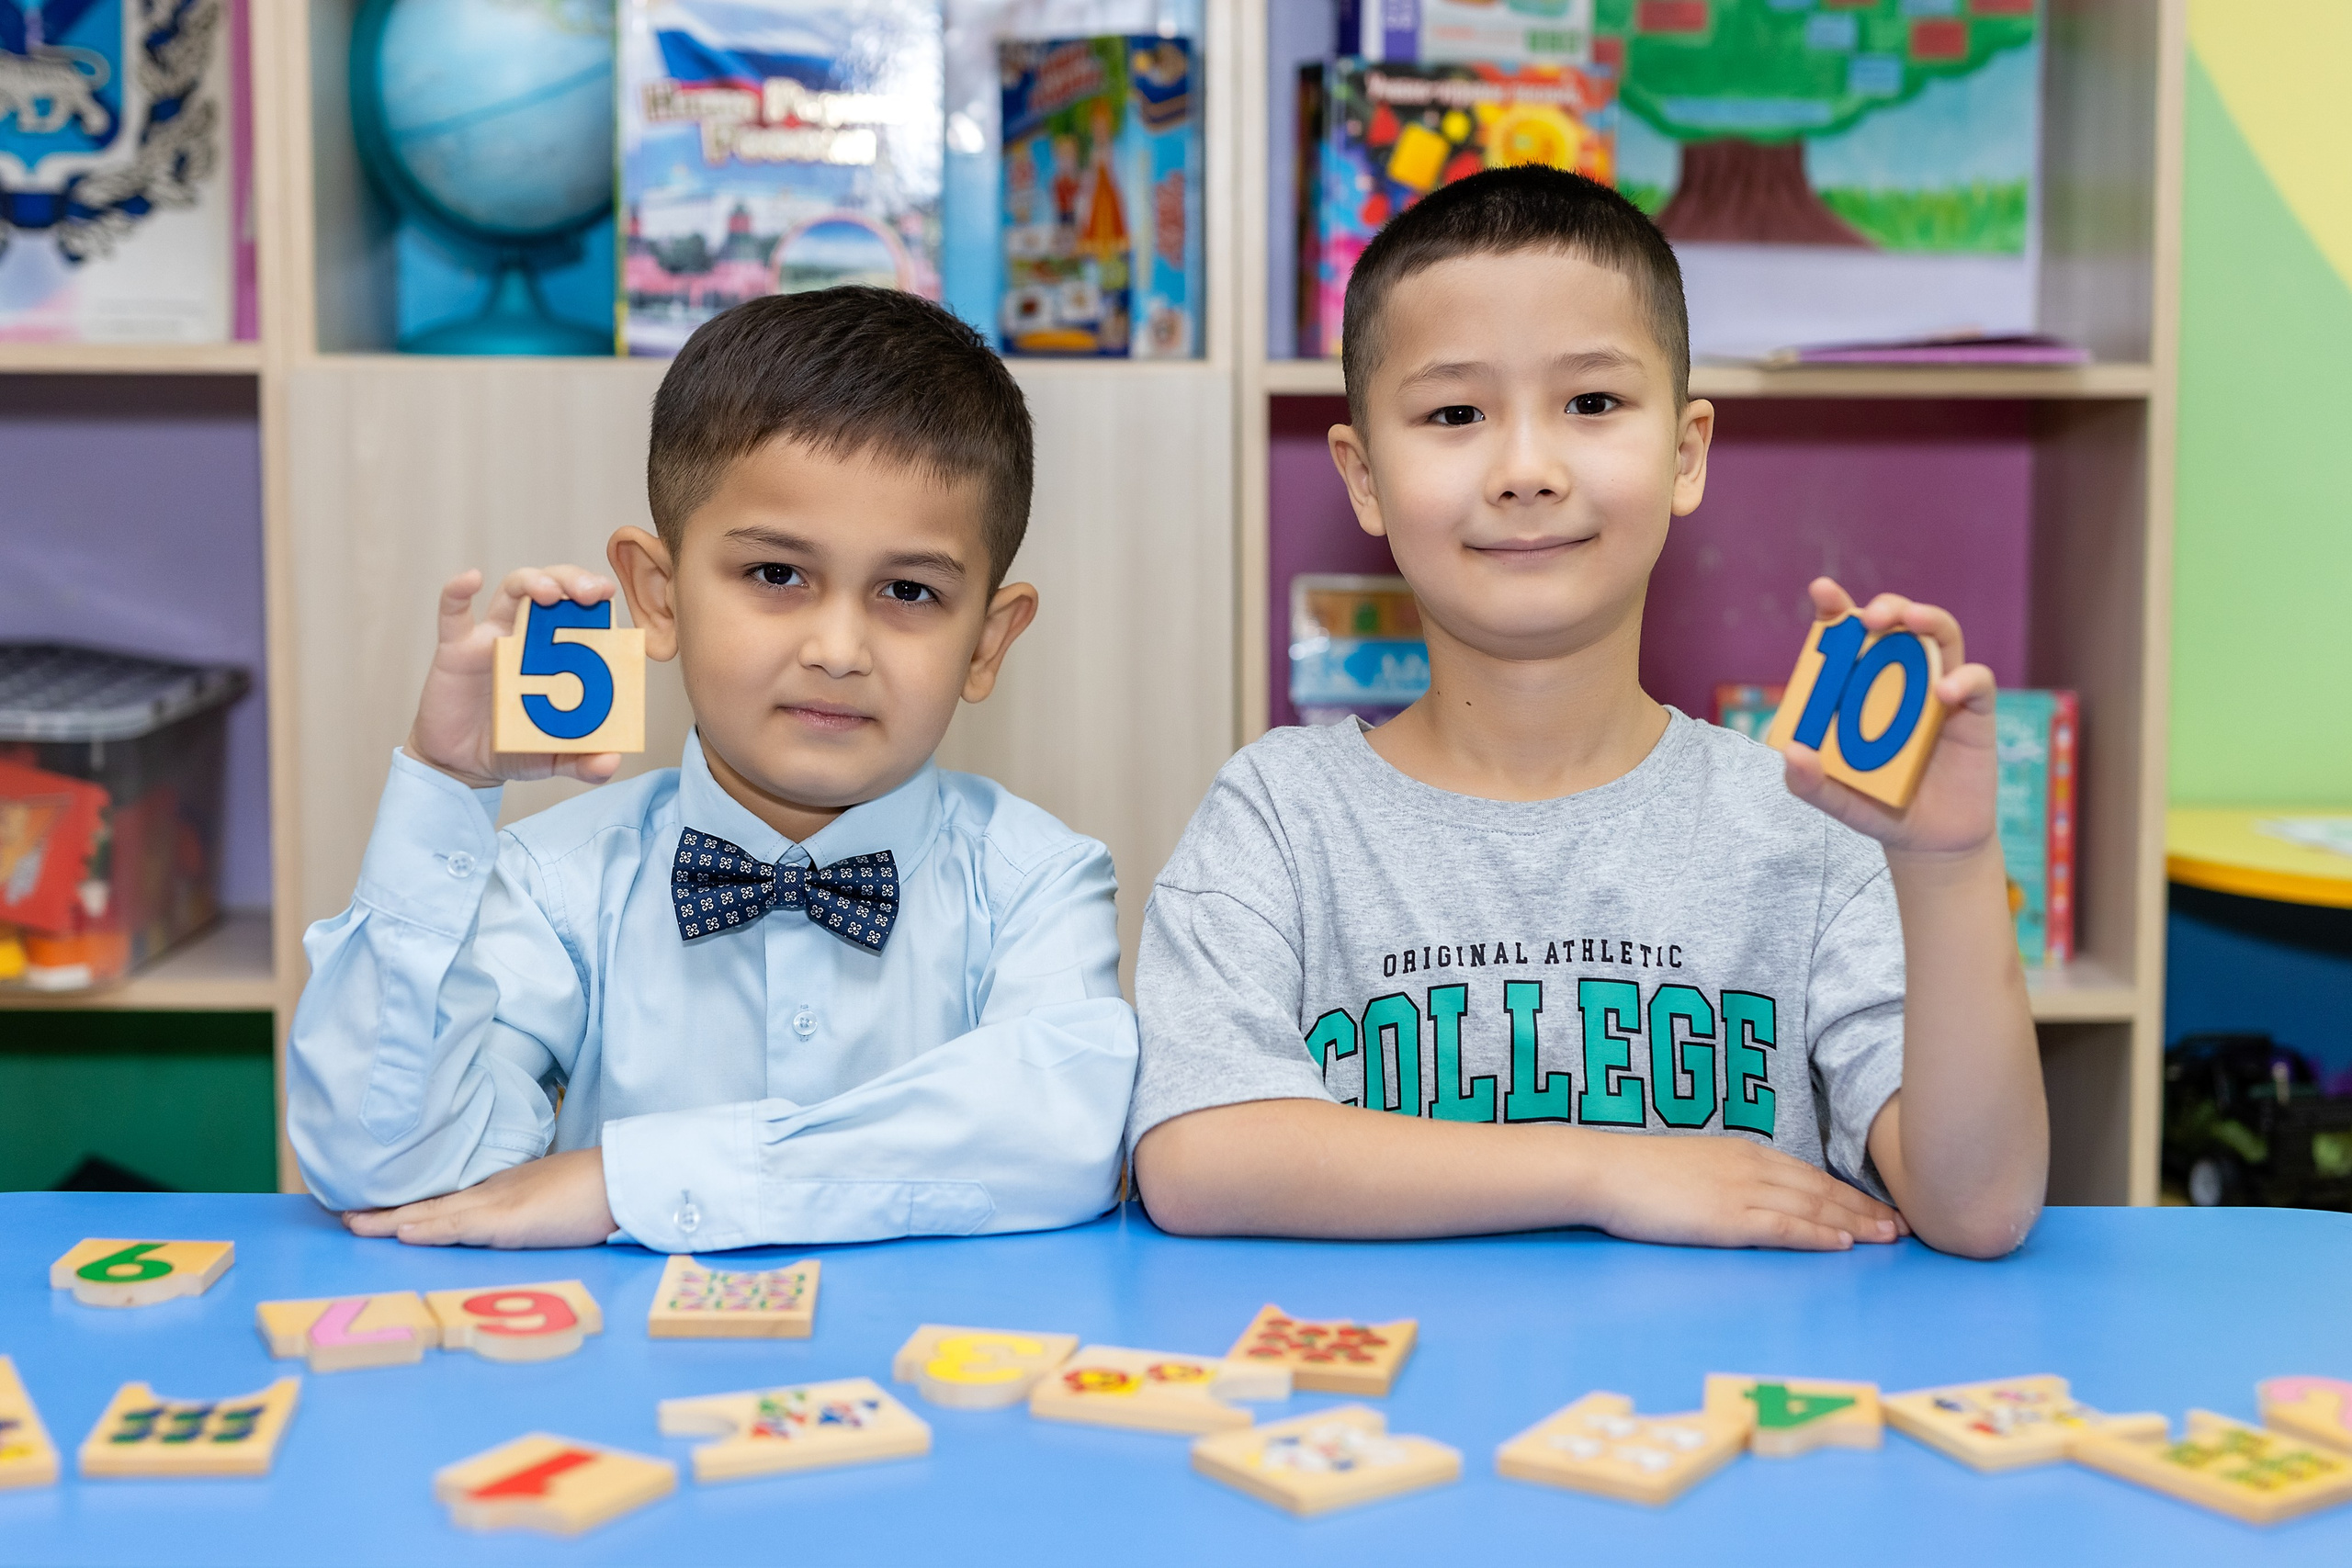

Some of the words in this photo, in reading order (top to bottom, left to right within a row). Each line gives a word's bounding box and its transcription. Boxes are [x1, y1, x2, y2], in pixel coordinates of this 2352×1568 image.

[520, 599, 615, 739] 5
[1793, 615, 1928, 772] 10
[1383, 942, 1528, 977] ORIGINAL
[1544, 938, 1682, 968] ATHLETIC
[1305, 977, 1778, 1141] COLLEGE
[308, 1298, 413, 1347] 7
[927, 1334, 1044, 1384] 3
[1742, 1383, 1856, 1429] 4
